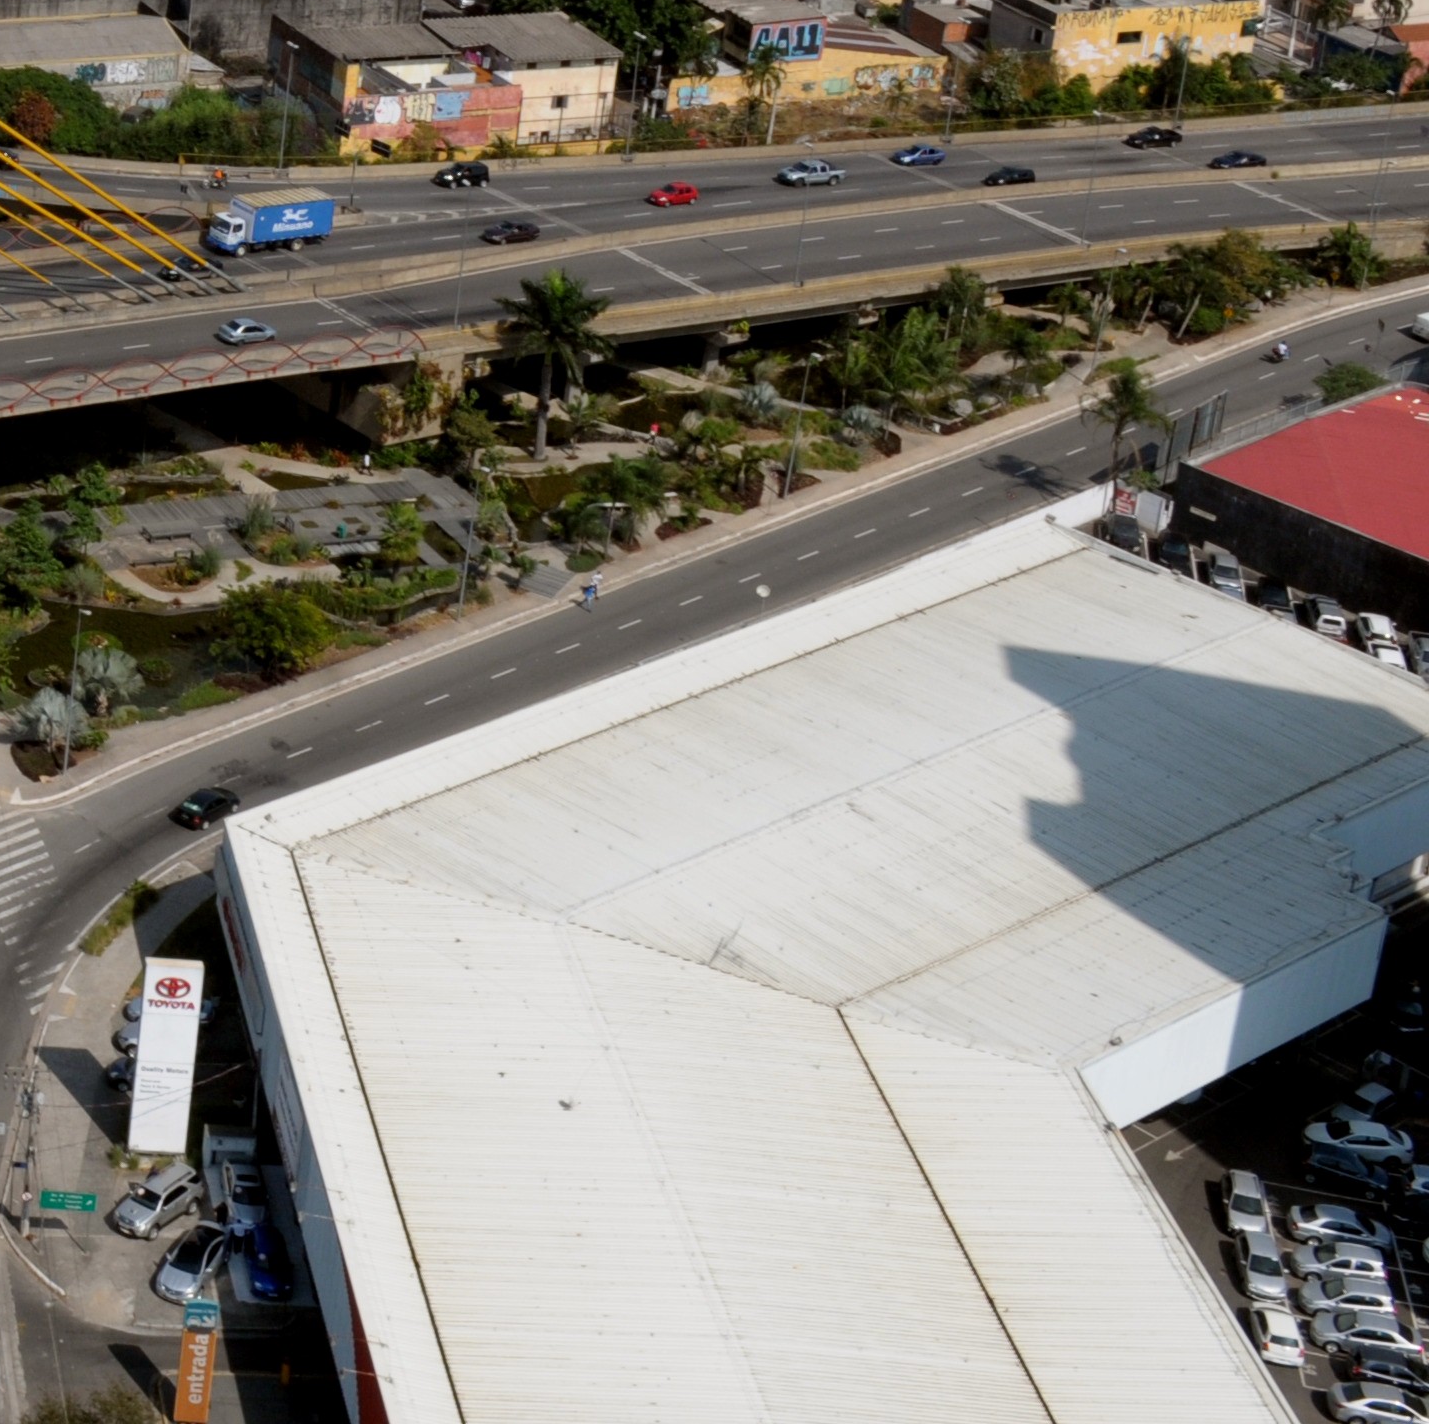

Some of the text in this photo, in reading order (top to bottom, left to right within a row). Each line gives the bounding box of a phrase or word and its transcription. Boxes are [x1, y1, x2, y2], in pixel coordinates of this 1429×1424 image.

[272, 220, 314, 233] Minuano
[147, 999, 196, 1010] TOYOTA
[140, 1065, 189, 1075] Quality Motors
[186, 1333, 210, 1405] entrada
